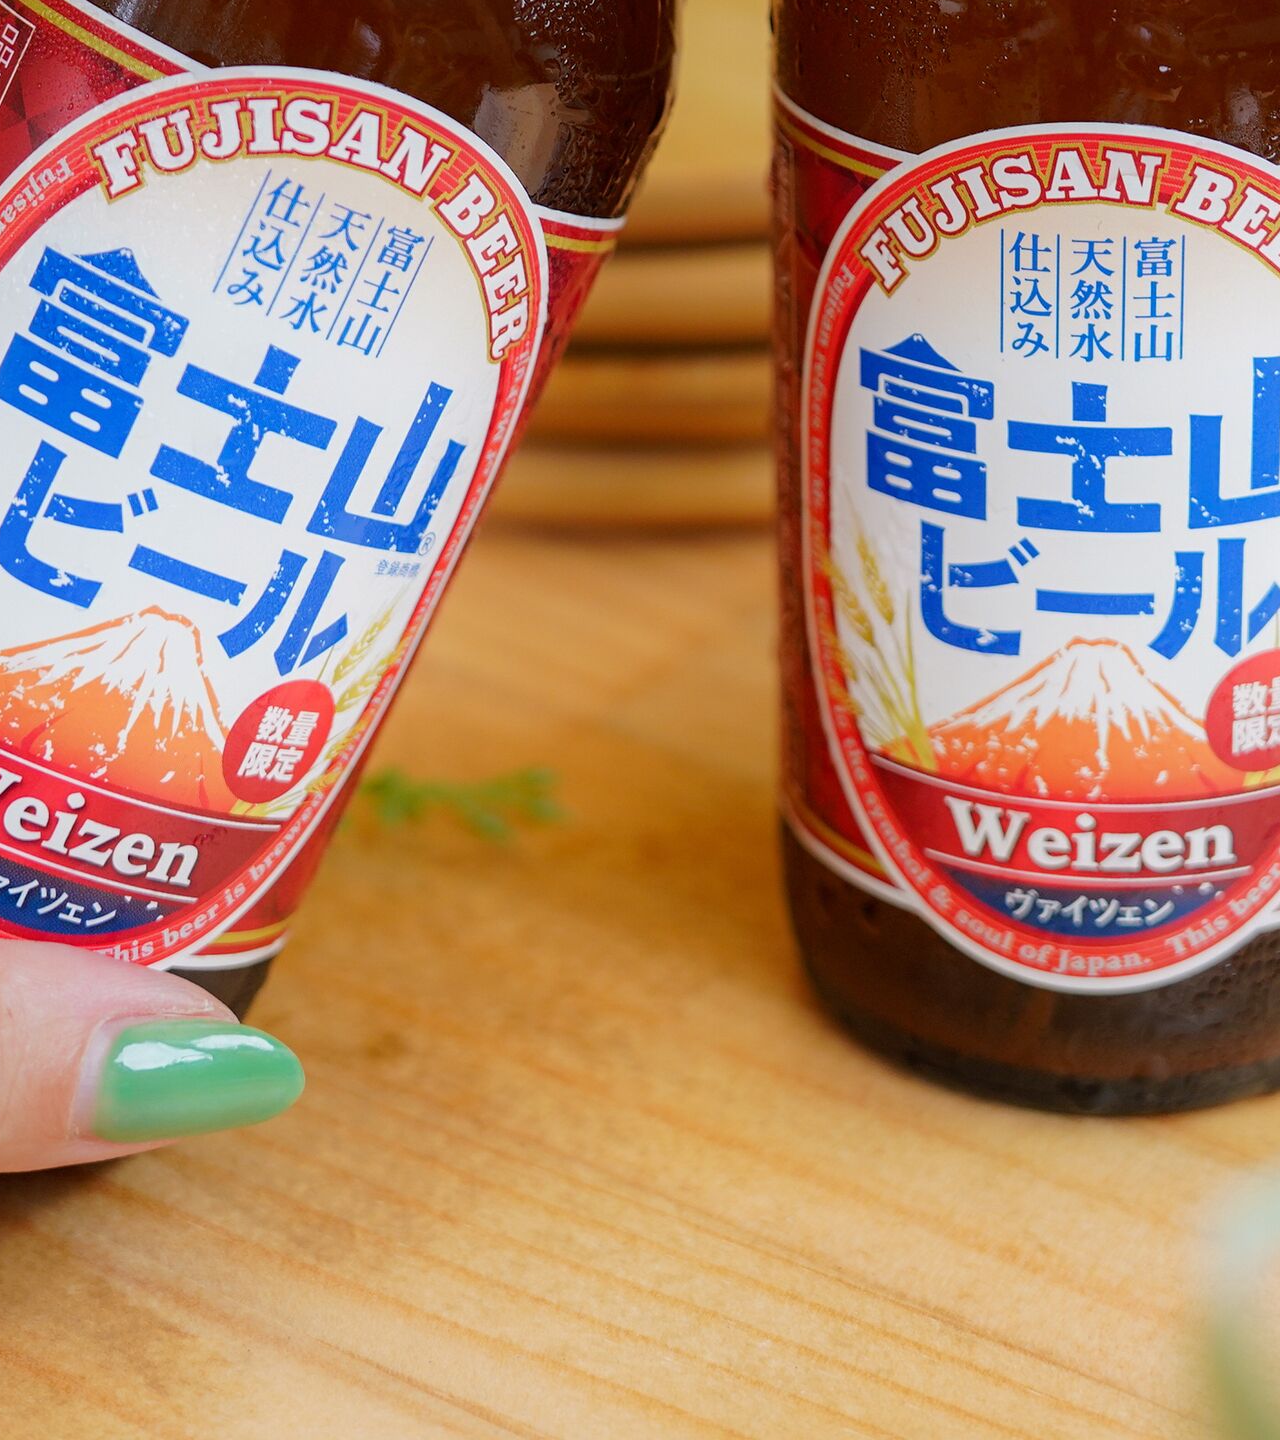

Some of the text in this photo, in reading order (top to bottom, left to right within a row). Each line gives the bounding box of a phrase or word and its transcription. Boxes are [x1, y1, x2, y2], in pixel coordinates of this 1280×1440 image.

[88, 93, 531, 361] FUJISAN BEER
[226, 177, 311, 308] 仕込み
[279, 202, 372, 334] 天然水
[856, 145, 1167, 295] FUJISAN
[339, 224, 426, 356] 富士山
[1009, 230, 1052, 359] 仕込み
[1070, 237, 1114, 362] 天然水
[1133, 236, 1177, 362] 富士山
[817, 263, 856, 347] Fujisan
[864, 791, 933, 885] symbol
[954, 909, 1015, 952] soul
[1018, 943, 1056, 965] of
[1053, 949, 1152, 976] Japan.
[1165, 915, 1230, 956] This
[237, 741, 304, 784] 限定
[256, 705, 320, 747] 数量
[944, 795, 1238, 873] Weizen
[162, 904, 220, 947] beer
[224, 881, 246, 907] is
[1004, 886, 1175, 927] ヴァイツェン
